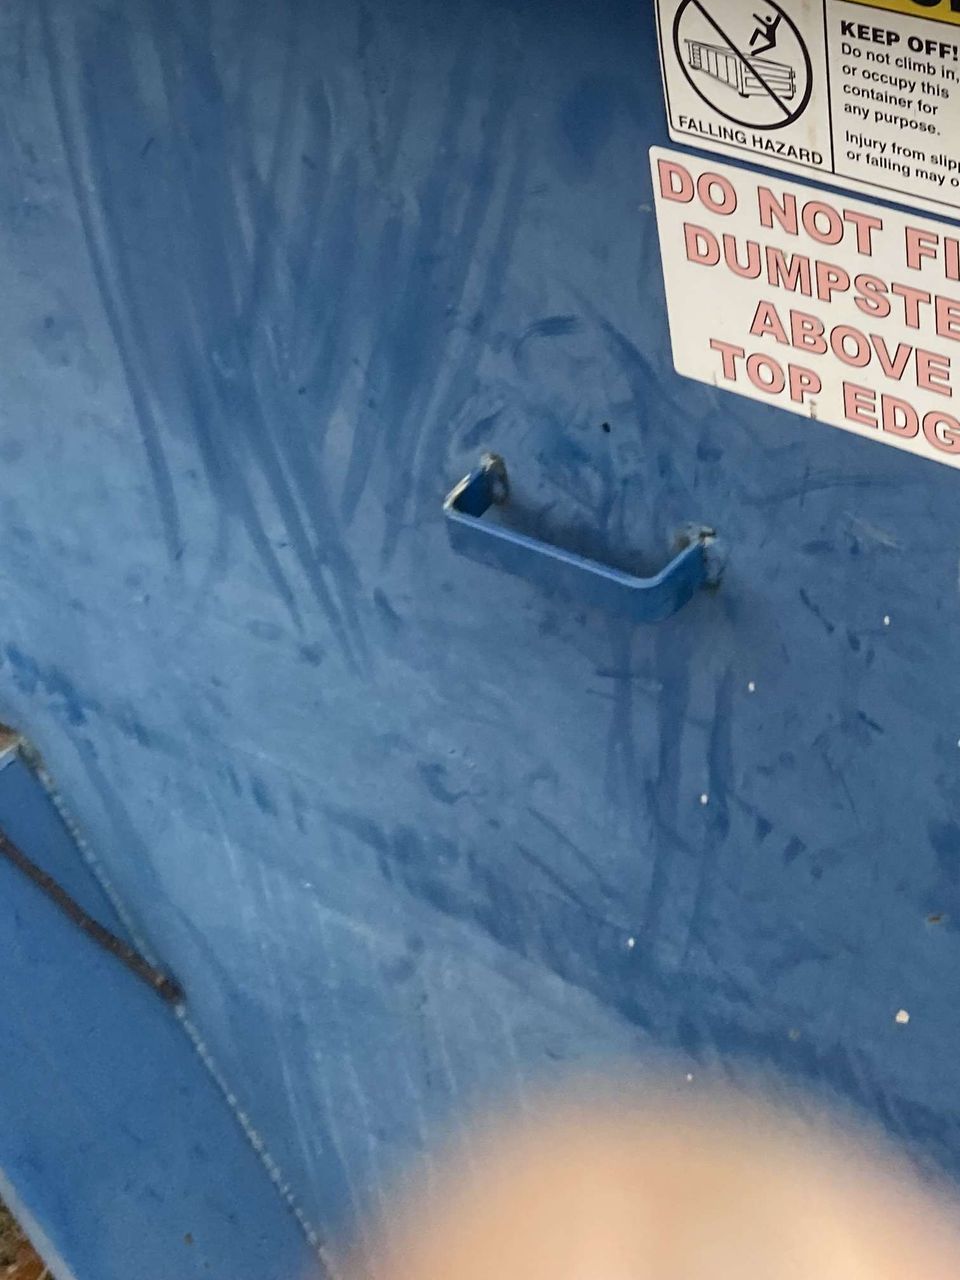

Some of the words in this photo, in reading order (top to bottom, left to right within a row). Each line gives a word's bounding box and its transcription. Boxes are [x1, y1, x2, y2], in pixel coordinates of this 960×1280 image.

[840, 20, 900, 47] KEEP
[907, 36, 959, 62] OFF!
[841, 42, 862, 58] Do
[866, 50, 890, 66] not
[895, 57, 937, 75] climb
[941, 65, 960, 84] in,
[842, 64, 857, 75] or
[862, 68, 916, 94] occupy
[921, 81, 950, 99] this
[843, 83, 913, 110] container
[917, 99, 938, 116] for
[844, 102, 869, 120] any
[874, 110, 941, 136] purpose.
[679, 115, 747, 145] FALLING
[752, 134, 823, 165] HAZARD
[845, 130, 887, 154] Injury
[892, 142, 926, 162] from
[846, 150, 862, 162] or
[866, 156, 911, 178] falling
[915, 167, 946, 187] may
[656, 158, 738, 216] DO
[757, 185, 883, 257] NOT
[749, 299, 953, 397] ABOVE
[709, 338, 822, 404] TOP
